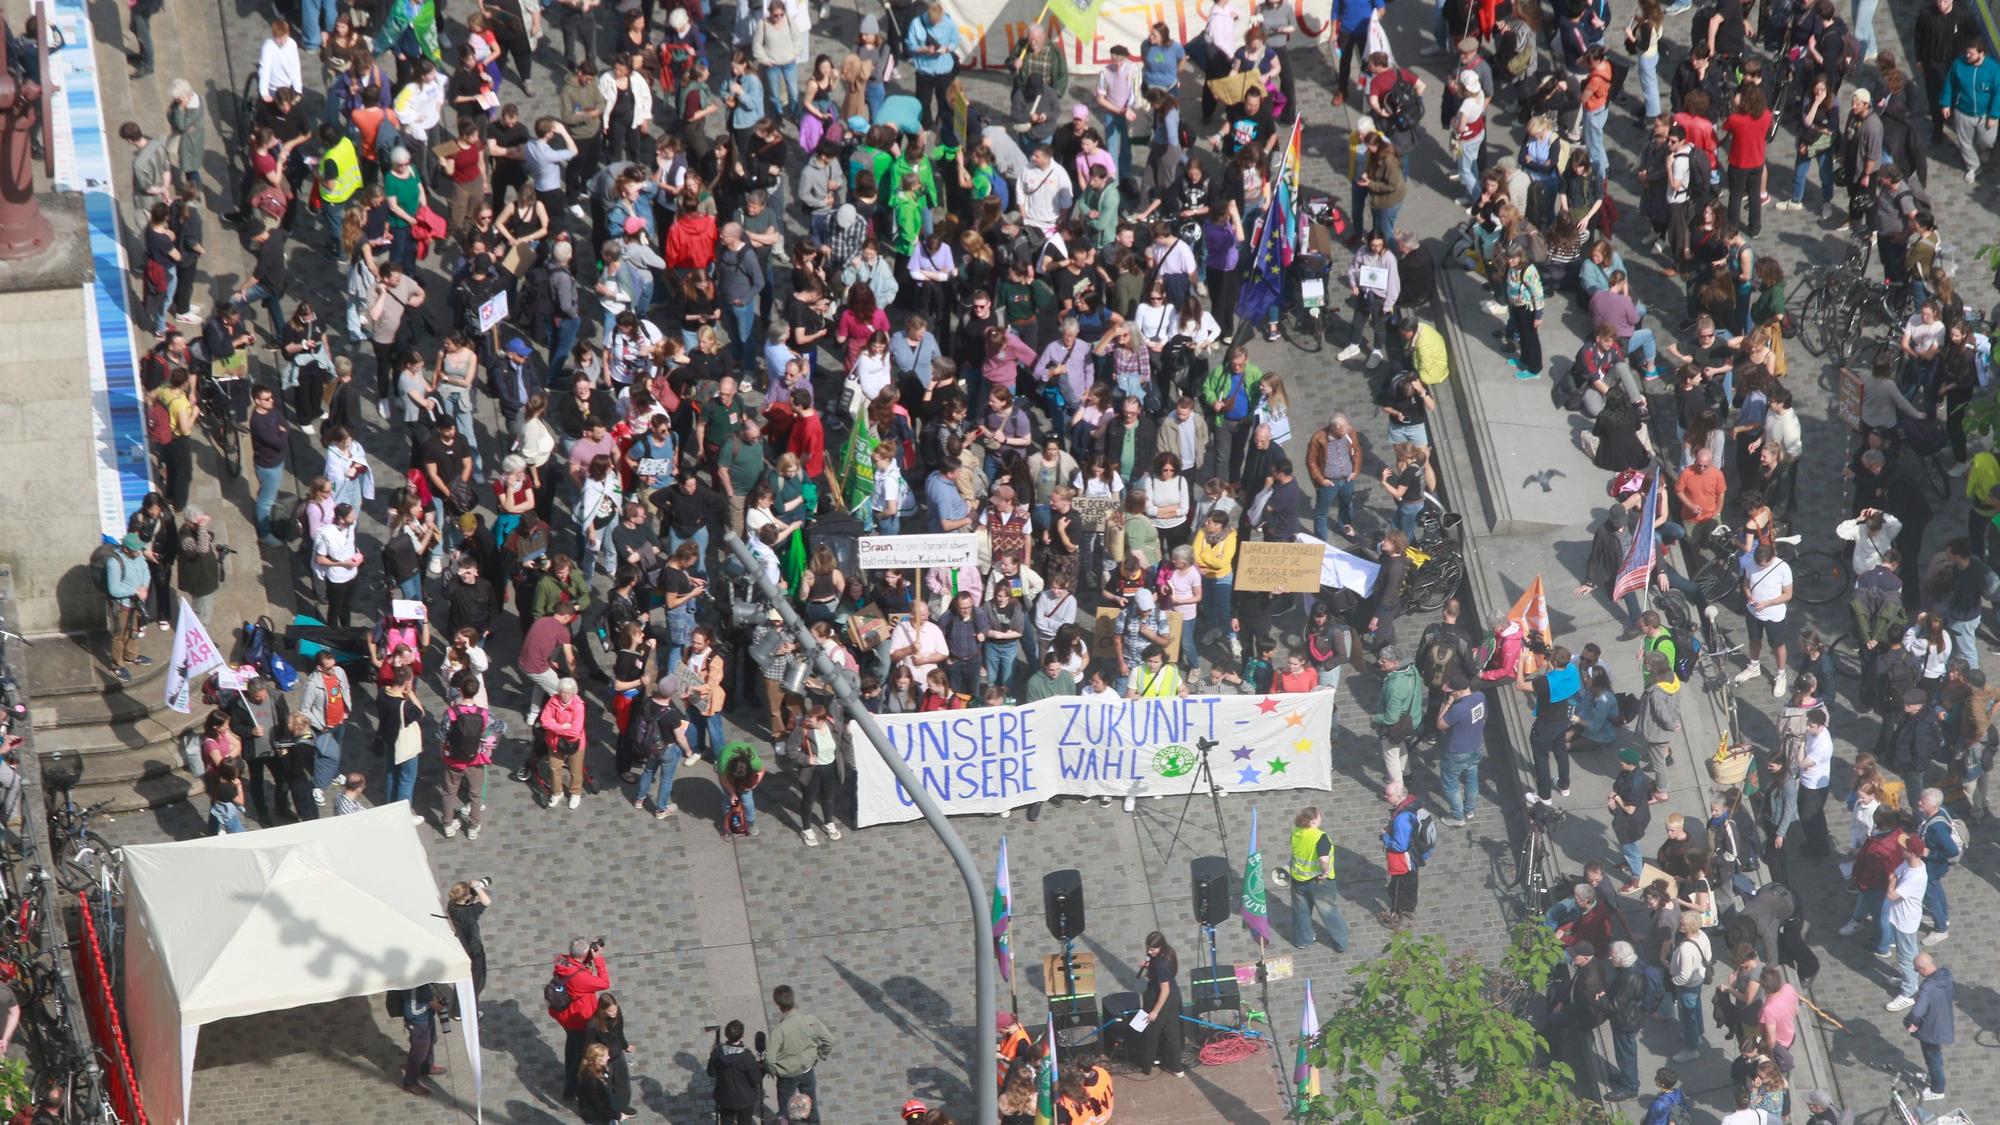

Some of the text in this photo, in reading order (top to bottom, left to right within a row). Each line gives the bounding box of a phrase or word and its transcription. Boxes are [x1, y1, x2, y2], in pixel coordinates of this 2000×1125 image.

[1088, 500, 1120, 510] OCEANS
[861, 541, 893, 553] Braun
[887, 709, 1036, 762] UNSERE
[1058, 697, 1221, 747] ZUKUNFT
[1058, 747, 1145, 780] WAHL
